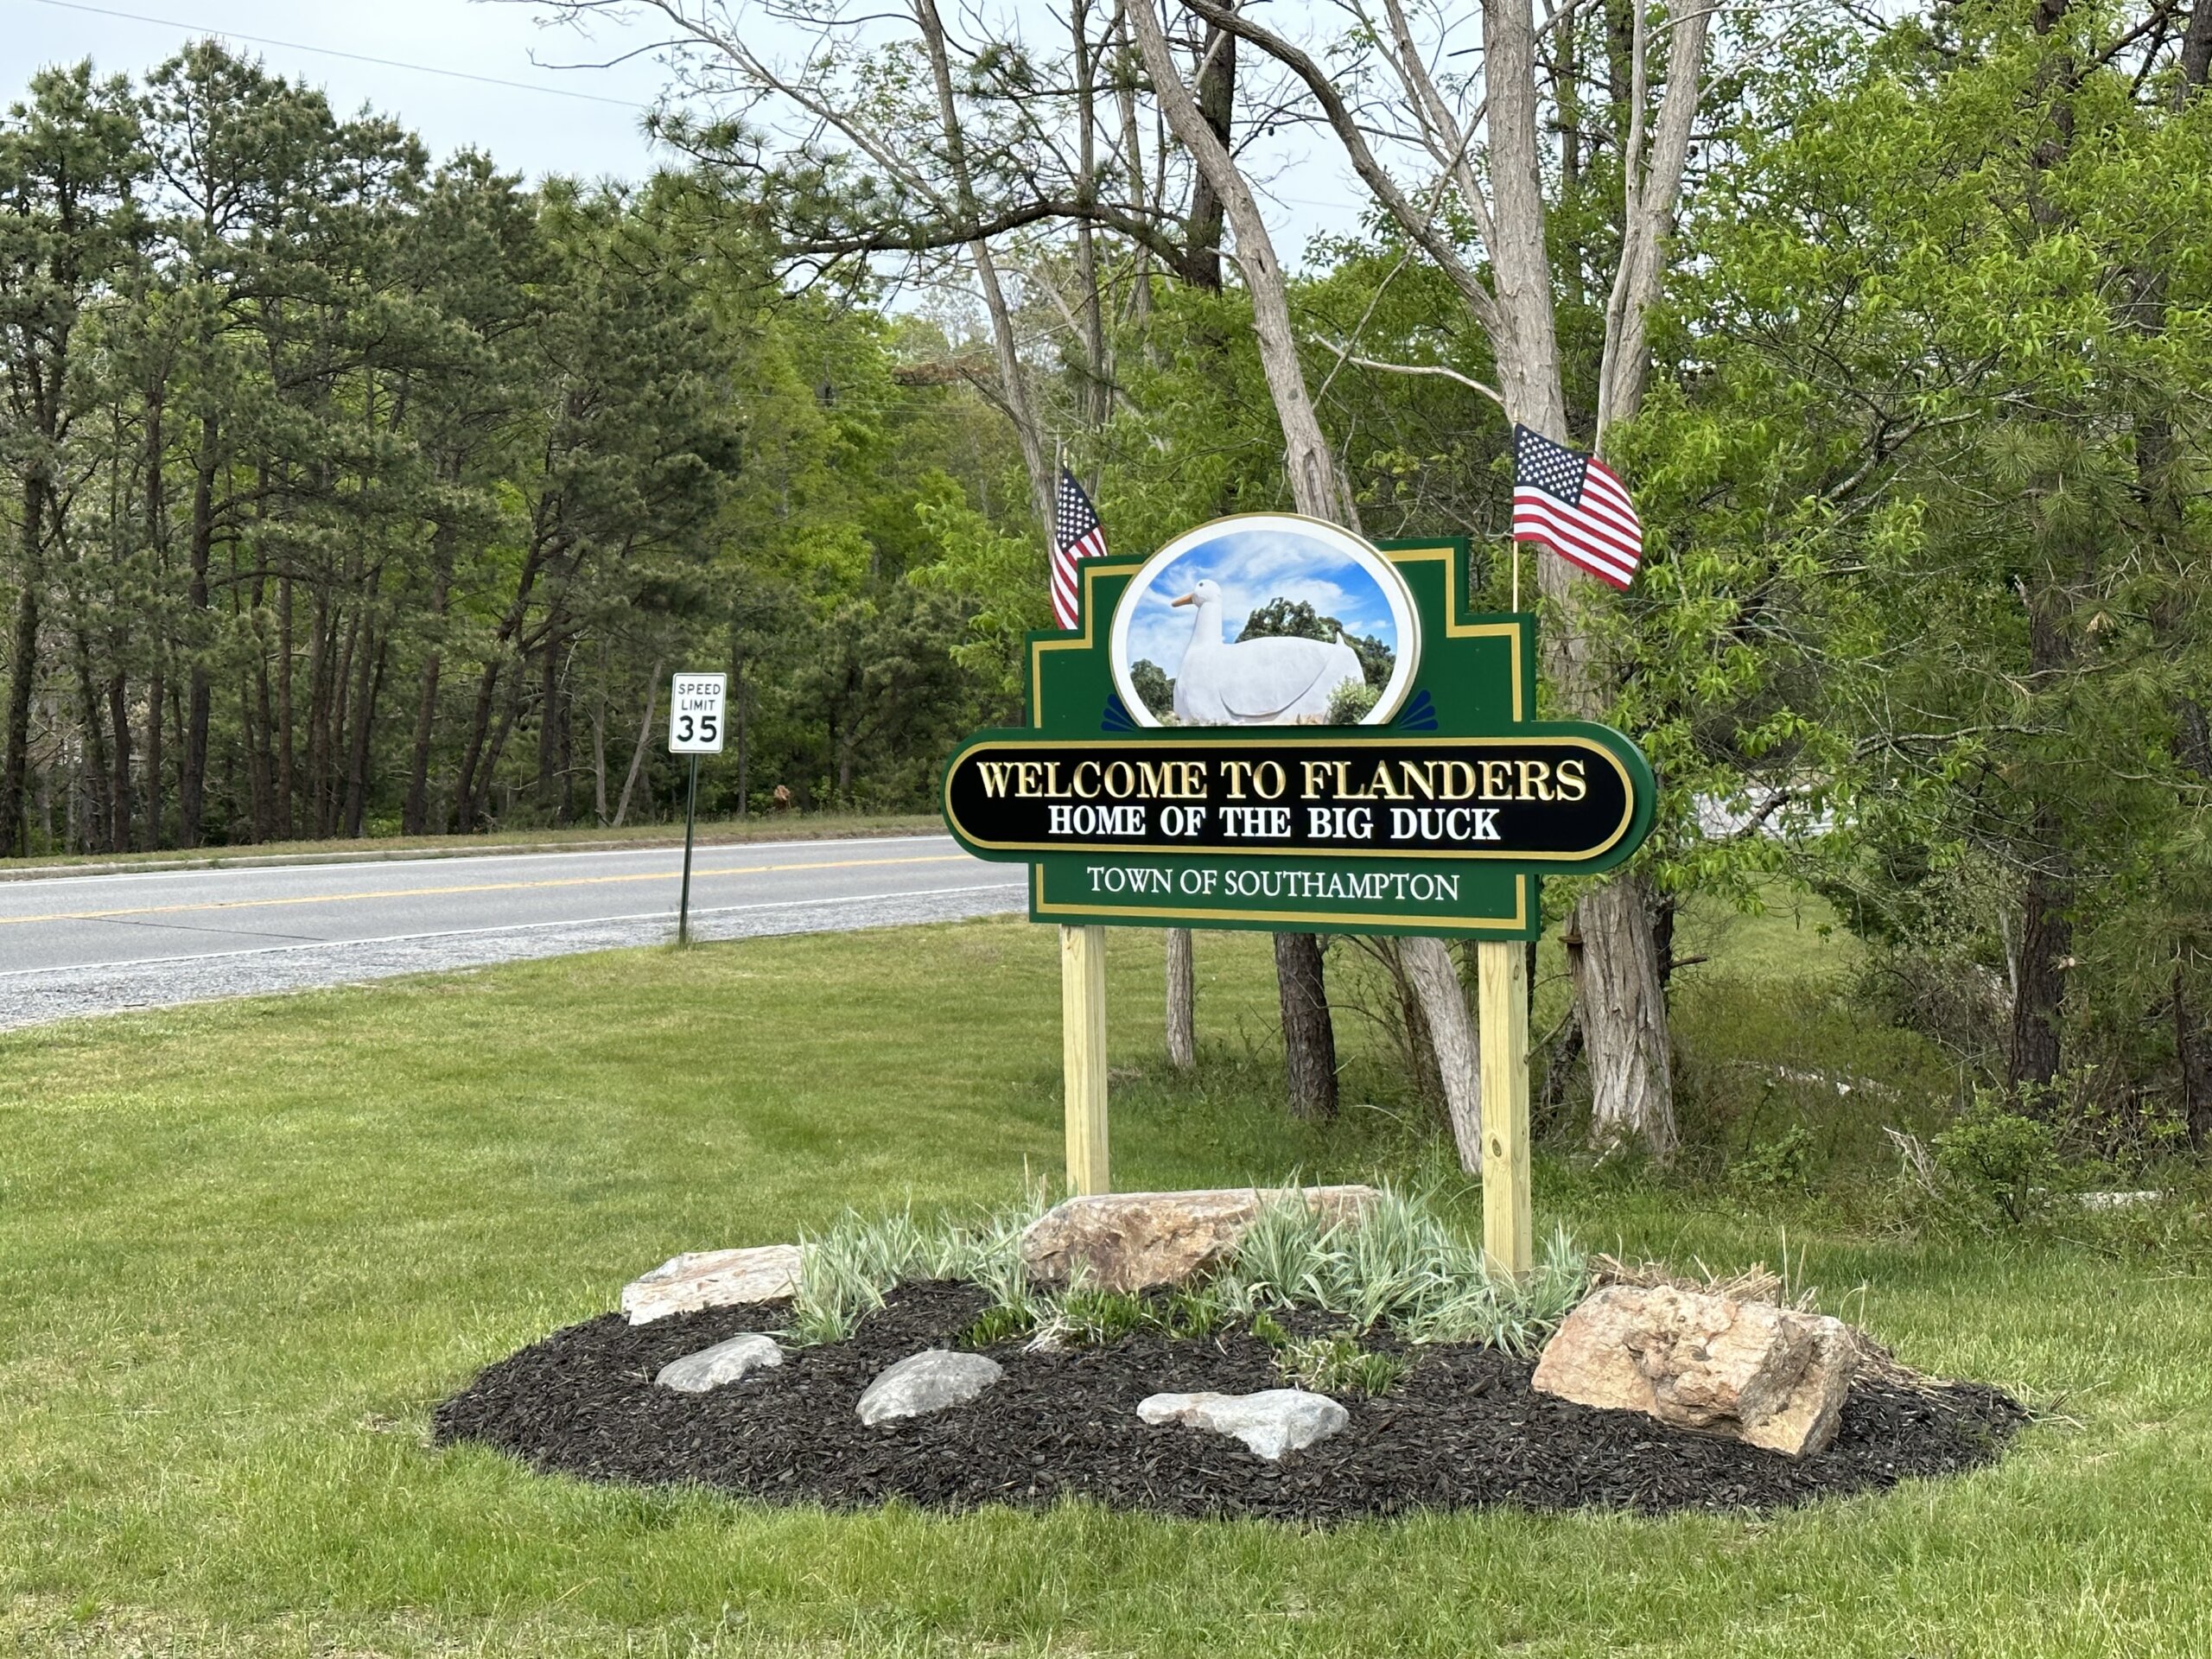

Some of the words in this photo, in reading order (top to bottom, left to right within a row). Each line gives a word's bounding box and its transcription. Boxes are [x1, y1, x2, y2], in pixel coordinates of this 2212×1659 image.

[677, 683, 721, 695] SPEED
[681, 699, 715, 711] LIMIT
[677, 715, 716, 742] 35
[976, 761, 1208, 799] WELCOME
[1219, 761, 1287, 800] TO
[1300, 760, 1586, 802] FLANDERS
[1047, 805, 1147, 836] HOME
[1160, 805, 1206, 836] OF
[1218, 806, 1292, 837] THE
[1306, 807, 1375, 840] BIG
[1389, 808, 1502, 841] DUCK
[1086, 867, 1173, 894] TOWN
[1179, 868, 1217, 895] OF
[1224, 870, 1460, 901] SOUTHAMPTON
